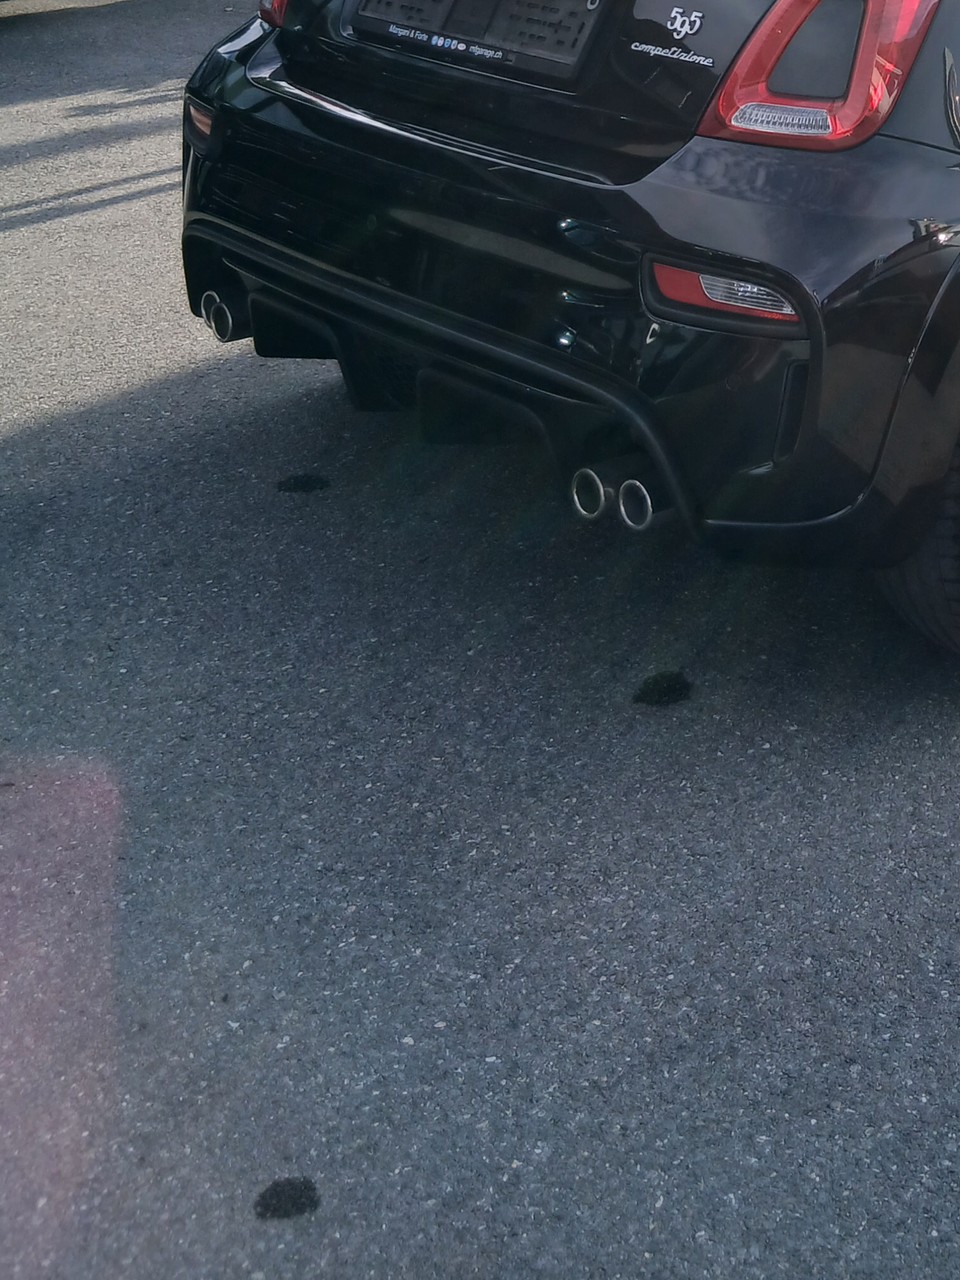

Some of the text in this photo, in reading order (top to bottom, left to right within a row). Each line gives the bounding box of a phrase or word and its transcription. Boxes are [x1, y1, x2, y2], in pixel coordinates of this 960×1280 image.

[388, 24, 411, 37] Mangani
[414, 31, 428, 41] Forte
[667, 7, 703, 39] 595
[631, 42, 713, 66] competizione
